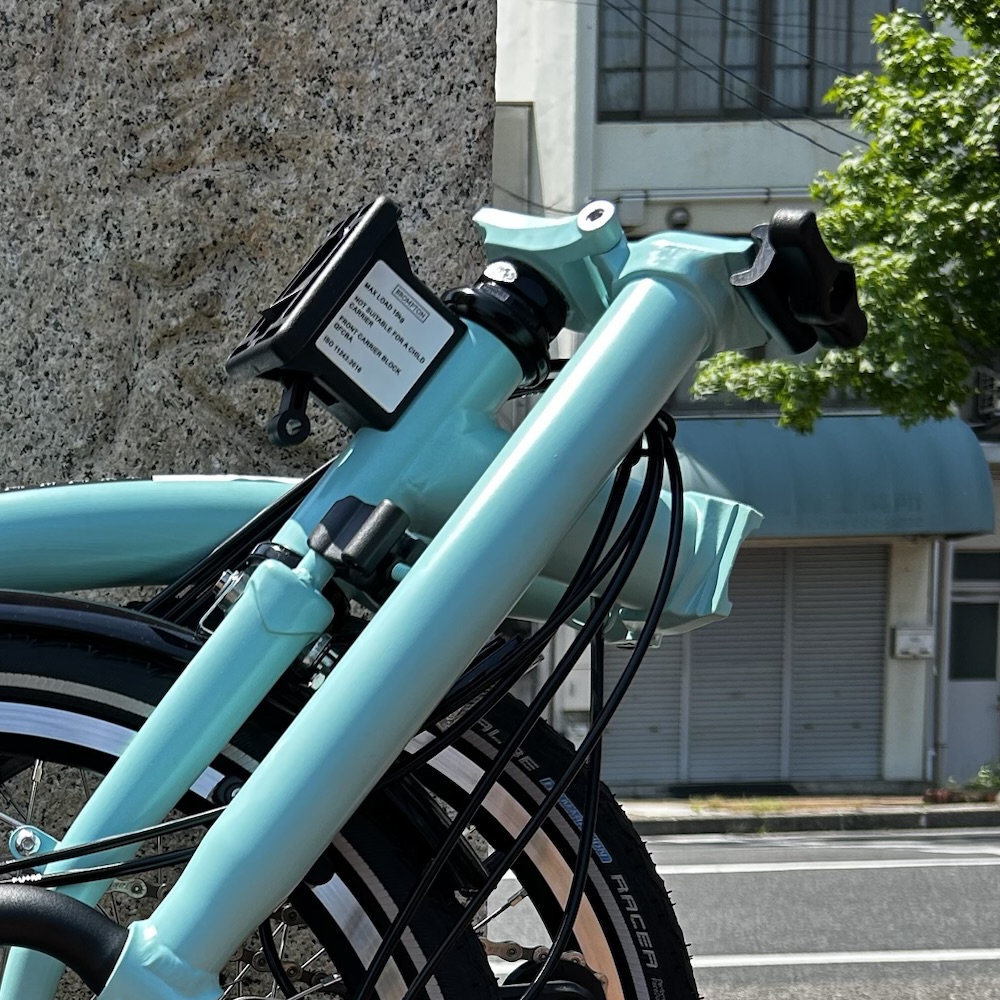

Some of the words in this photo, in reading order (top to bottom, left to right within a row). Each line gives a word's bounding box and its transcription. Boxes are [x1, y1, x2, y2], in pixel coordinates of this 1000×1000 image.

[364, 282, 377, 296] MAX
[376, 294, 393, 311] LOAD
[395, 288, 427, 319] BROMPTON
[349, 303, 374, 328] CARRIER
[354, 296, 367, 309] NOT
[366, 306, 392, 334] SUITABLE
[392, 330, 404, 344] FOR
[408, 346, 426, 364] CHILD
[323, 336, 335, 348] ISO
[339, 315, 358, 335] FRONT
[357, 332, 384, 357] CARRIER
[381, 355, 402, 376] BLOCK
[610, 874, 659, 969] RACER
